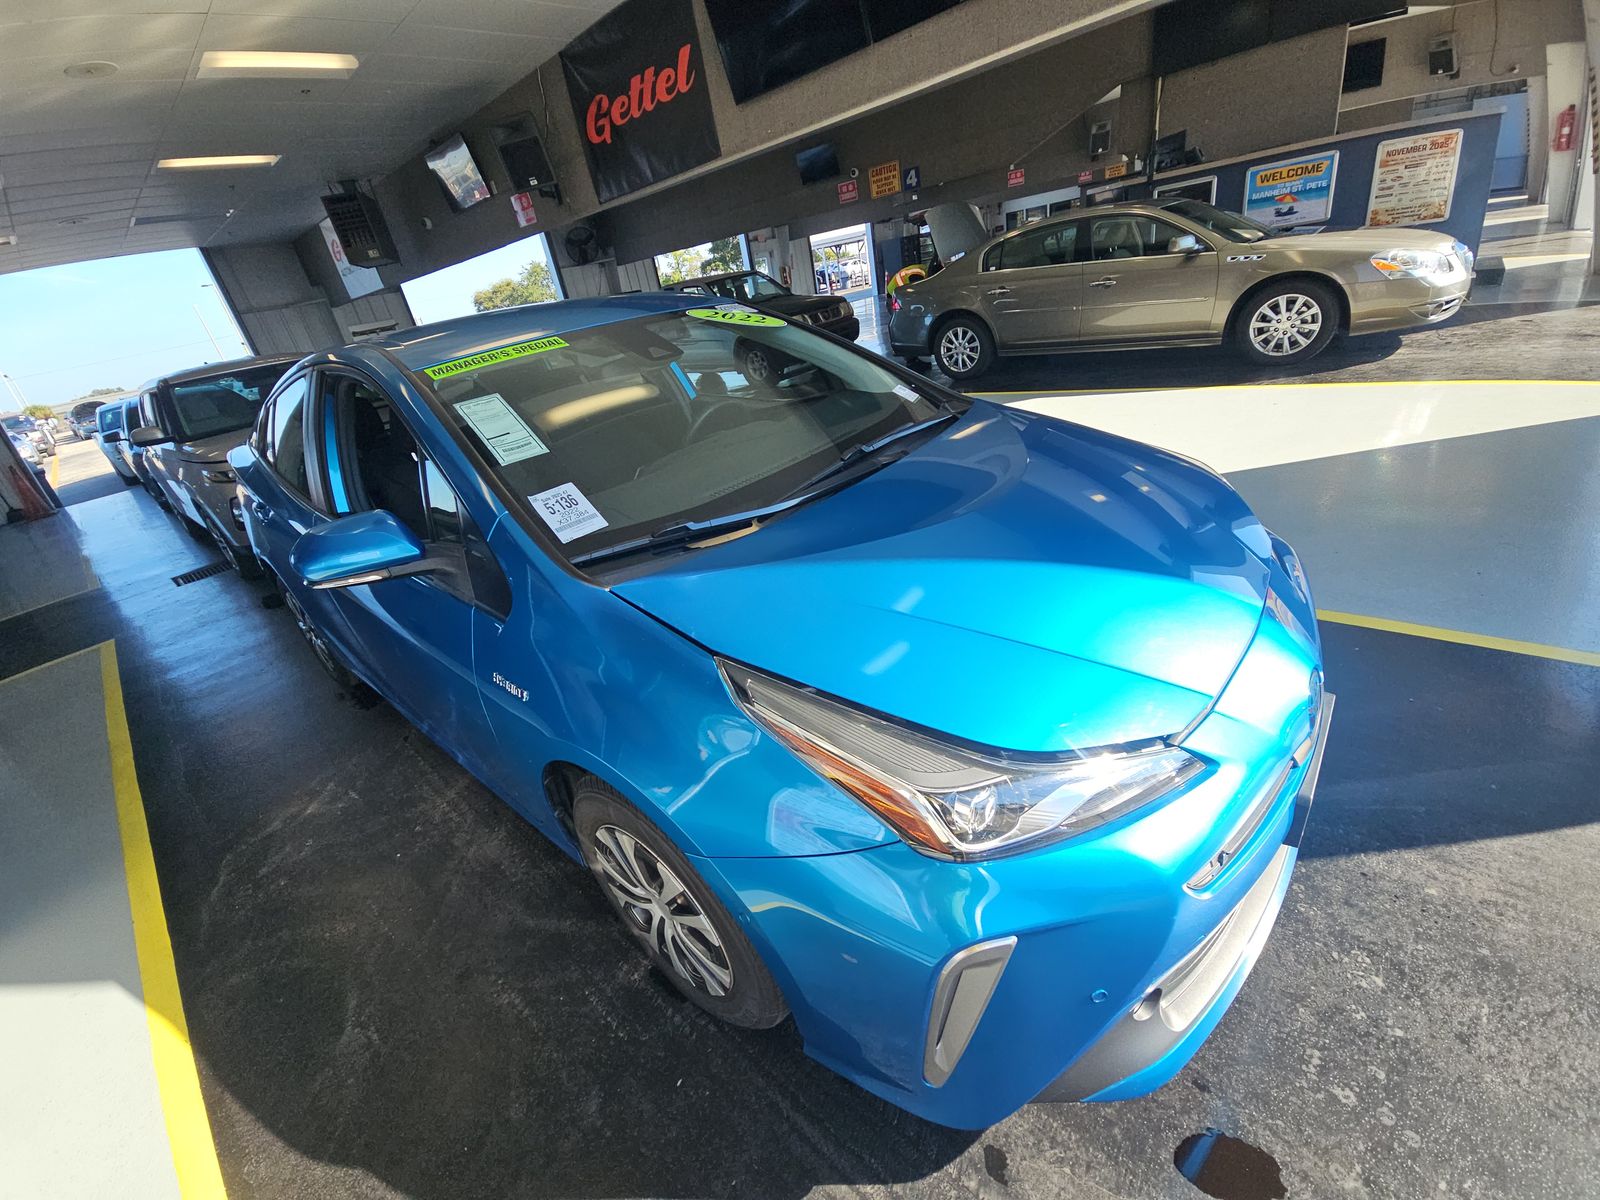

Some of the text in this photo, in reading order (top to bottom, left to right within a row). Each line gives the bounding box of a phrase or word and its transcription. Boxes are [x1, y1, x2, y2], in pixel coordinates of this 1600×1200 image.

[586, 43, 696, 144] Gettel
[1385, 141, 1449, 158] NOVEMBER 2025
[871, 163, 897, 178] CAUTION
[906, 169, 917, 187] 4
[1259, 162, 1324, 184] WELCOME
[1252, 180, 1329, 200] MANHEIM ST. PETE
[705, 310, 767, 324] 2022
[431, 338, 562, 377] MANAGER'S SPECIAL
[543, 494, 579, 515] 5:136
[559, 507, 579, 518] 2022
